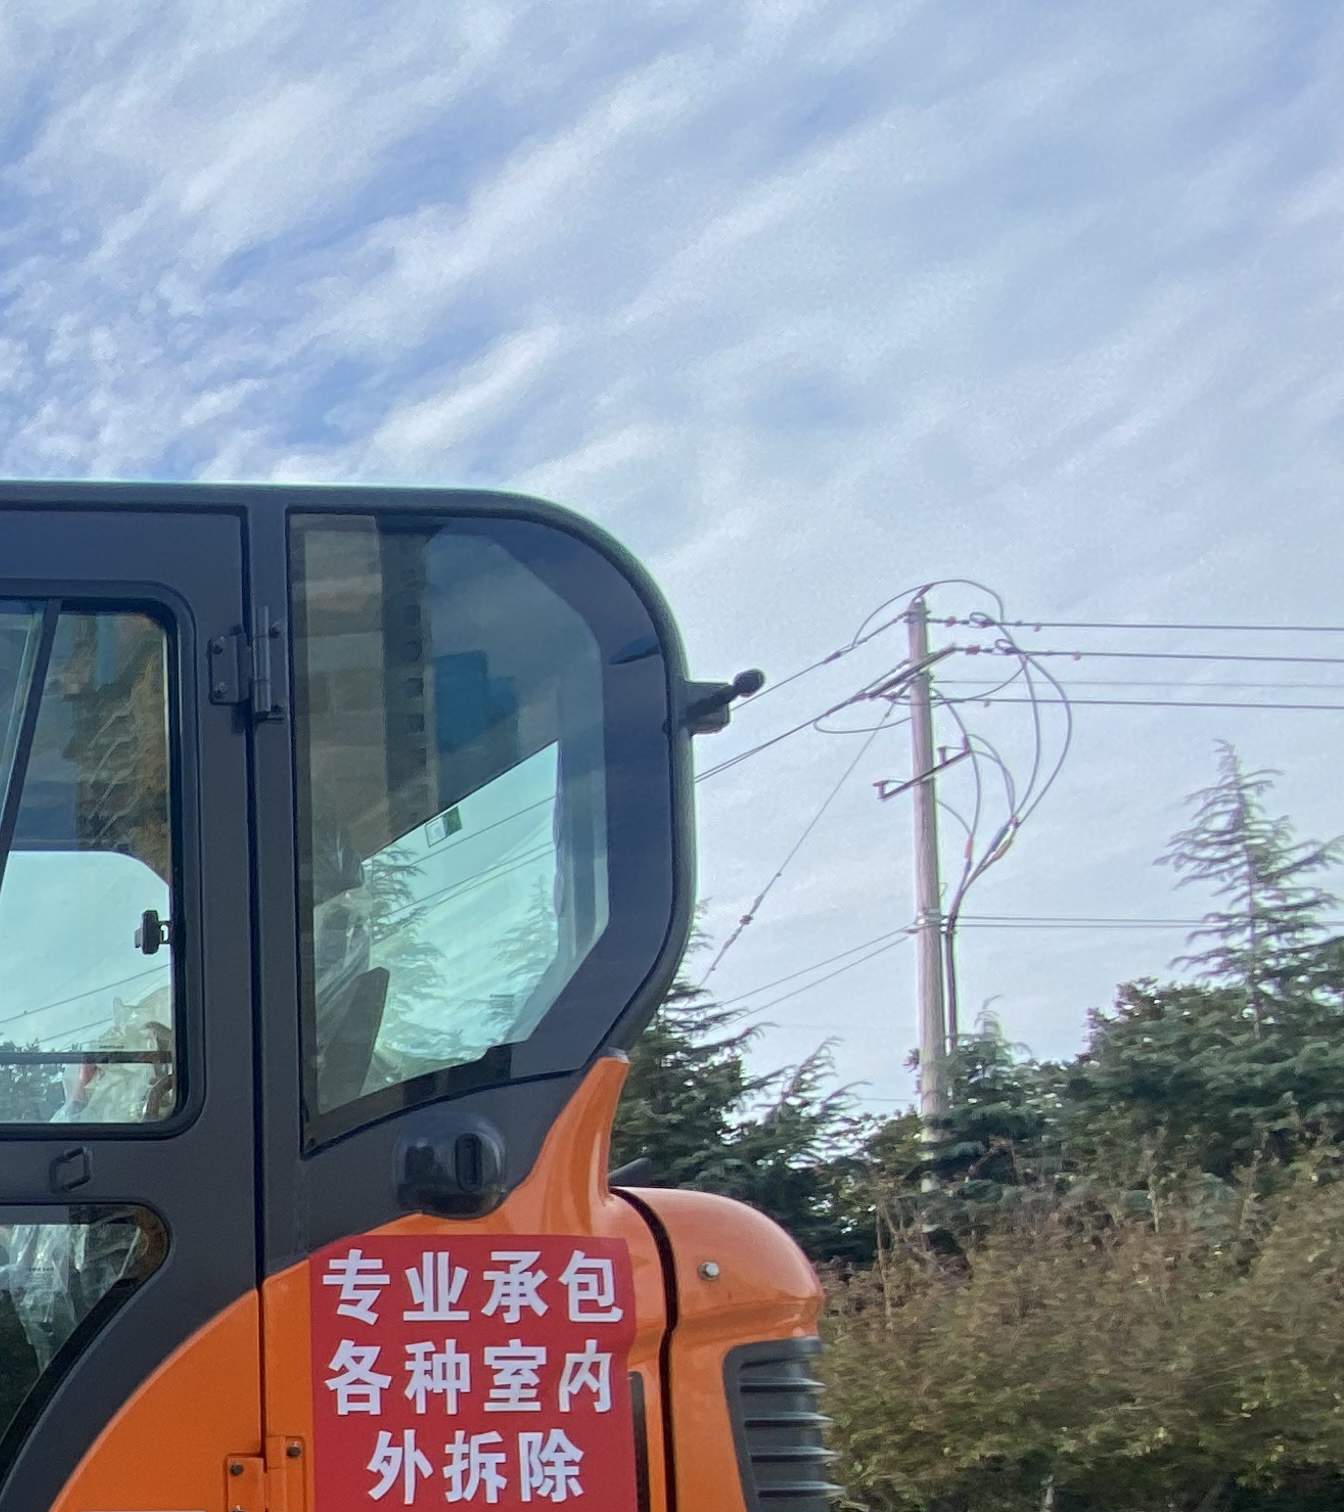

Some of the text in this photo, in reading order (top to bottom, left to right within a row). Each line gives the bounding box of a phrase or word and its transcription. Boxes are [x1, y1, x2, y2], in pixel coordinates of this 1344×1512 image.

[322, 1249, 624, 1326] 专业承包
[324, 1339, 612, 1416] 各种室内
[366, 1429, 584, 1504] 外拆除
